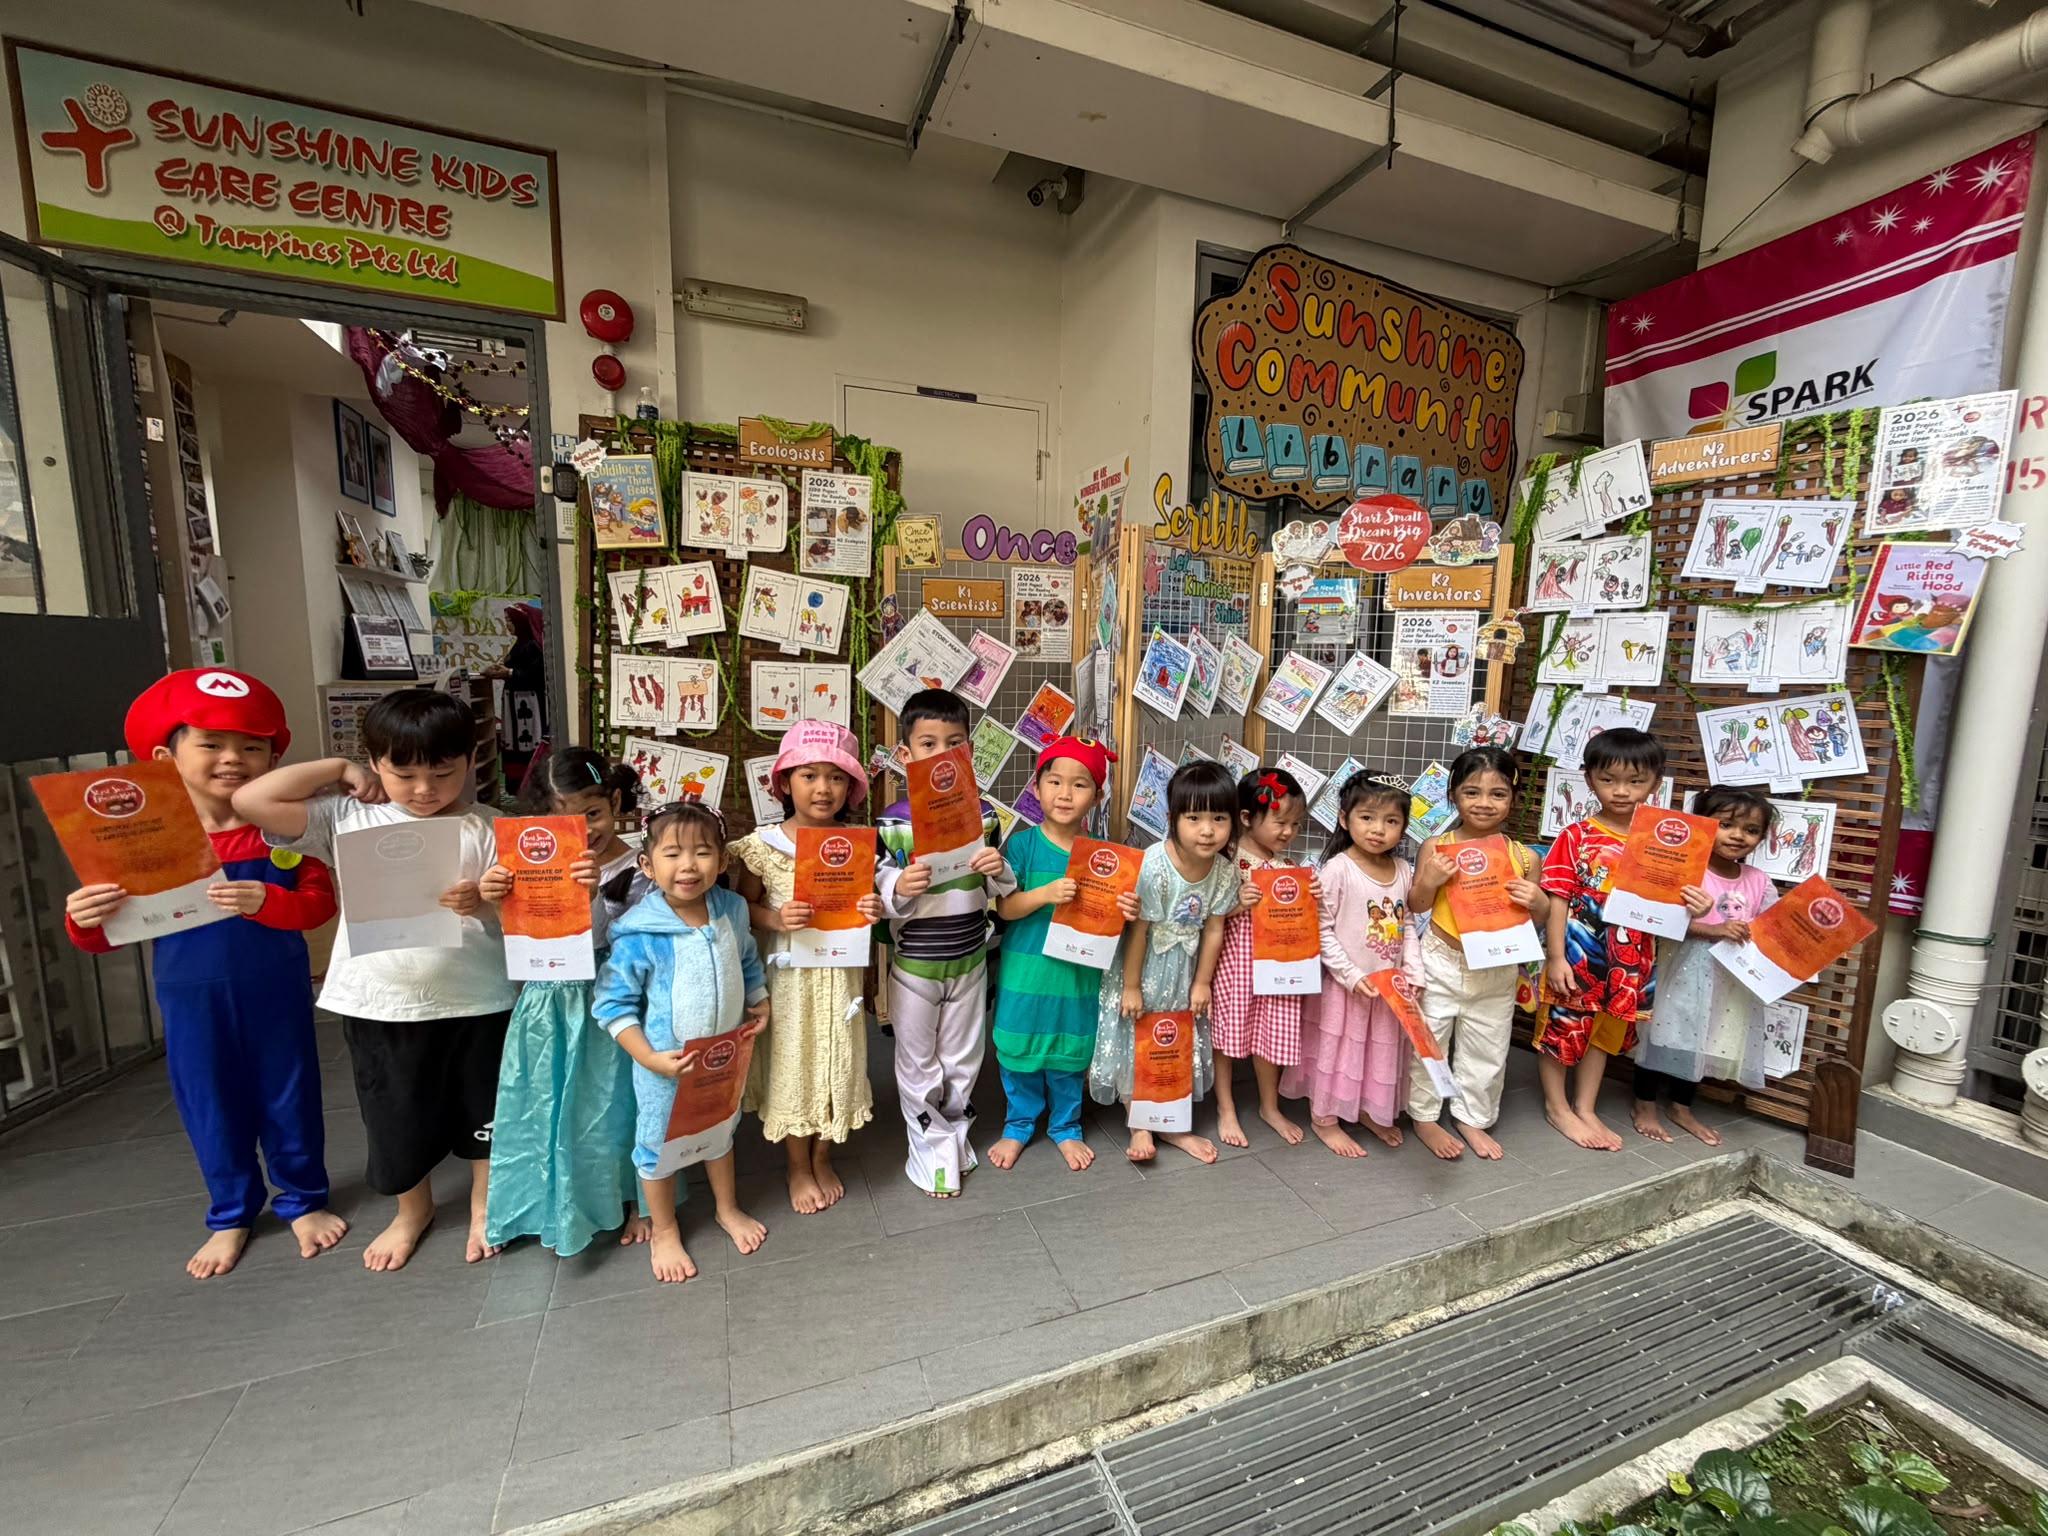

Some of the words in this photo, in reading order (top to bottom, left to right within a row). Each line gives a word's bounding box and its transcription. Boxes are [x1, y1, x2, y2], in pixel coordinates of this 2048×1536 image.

[146, 99, 420, 182] SUNSHINE
[430, 153, 538, 206] KIDS
[154, 158, 279, 206] CARE
[289, 180, 451, 237] CENTRE
[154, 205, 187, 236] @
[195, 214, 341, 265] Tampines
[345, 237, 403, 274] Pte
[406, 248, 459, 285] Ltd
[1265, 262, 1507, 393] Sunshine
[1216, 319, 1510, 472] Community
[1746, 358, 1880, 421] SPARK
[1891, 409, 1940, 425] 2026
[750, 441, 825, 462] Ecologists
[1702, 441, 1725, 457] N2
[1656, 448, 1772, 477] Adventurers
[628, 476, 653, 486] Three
[808, 477, 835, 488] 2026
[627, 485, 654, 496] Bears
[1154, 472, 1260, 559] Scribble
[1348, 508, 1383, 527] Start
[1383, 507, 1423, 525] Small
[904, 526, 930, 535] Once
[1347, 524, 1393, 542] Dream
[1393, 524, 1424, 542] Big
[907, 536, 929, 545] upon
[962, 514, 1078, 565] Once
[910, 550, 930, 559] Time
[1361, 543, 1405, 561] 2026
[1896, 563, 1921, 571] Little
[1925, 560, 1954, 571] Red
[1017, 573, 1040, 582] 2026
[1431, 572, 1450, 587] K2
[1906, 571, 1954, 583] Riding
[957, 585, 971, 598] K1
[1184, 575, 1233, 601] Kindness
[1398, 587, 1482, 602] Inventors
[1922, 581, 1964, 592] Hood
[930, 598, 998, 612] Scientists
[1215, 601, 1243, 624] Shine
[433, 617, 450, 635] A
[1402, 618, 1432, 627] 2026
[931, 629, 949, 645] STORY
[948, 643, 961, 654] MAP
[207, 678, 243, 692] M
